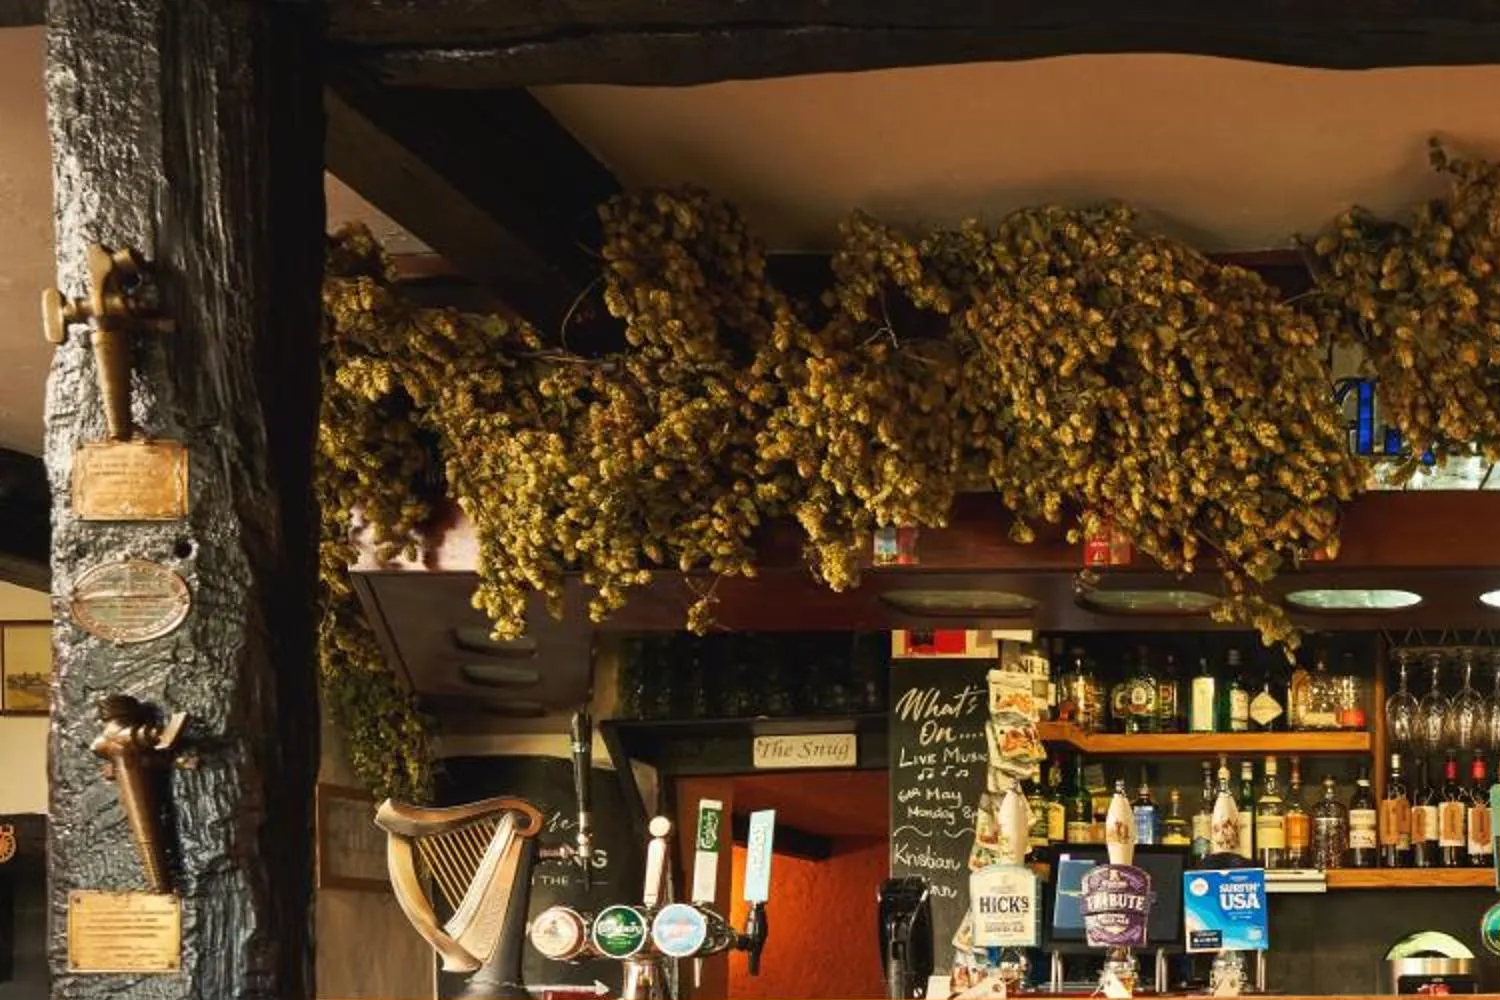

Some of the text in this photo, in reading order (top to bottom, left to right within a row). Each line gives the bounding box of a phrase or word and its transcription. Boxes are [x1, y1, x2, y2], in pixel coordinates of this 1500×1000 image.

[895, 684, 988, 722] What's
[757, 739, 849, 761] The Snug
[925, 787, 962, 809] May
[907, 805, 955, 826] Monday
[979, 895, 1029, 913] HICKS
[1219, 893, 1261, 911] USA
